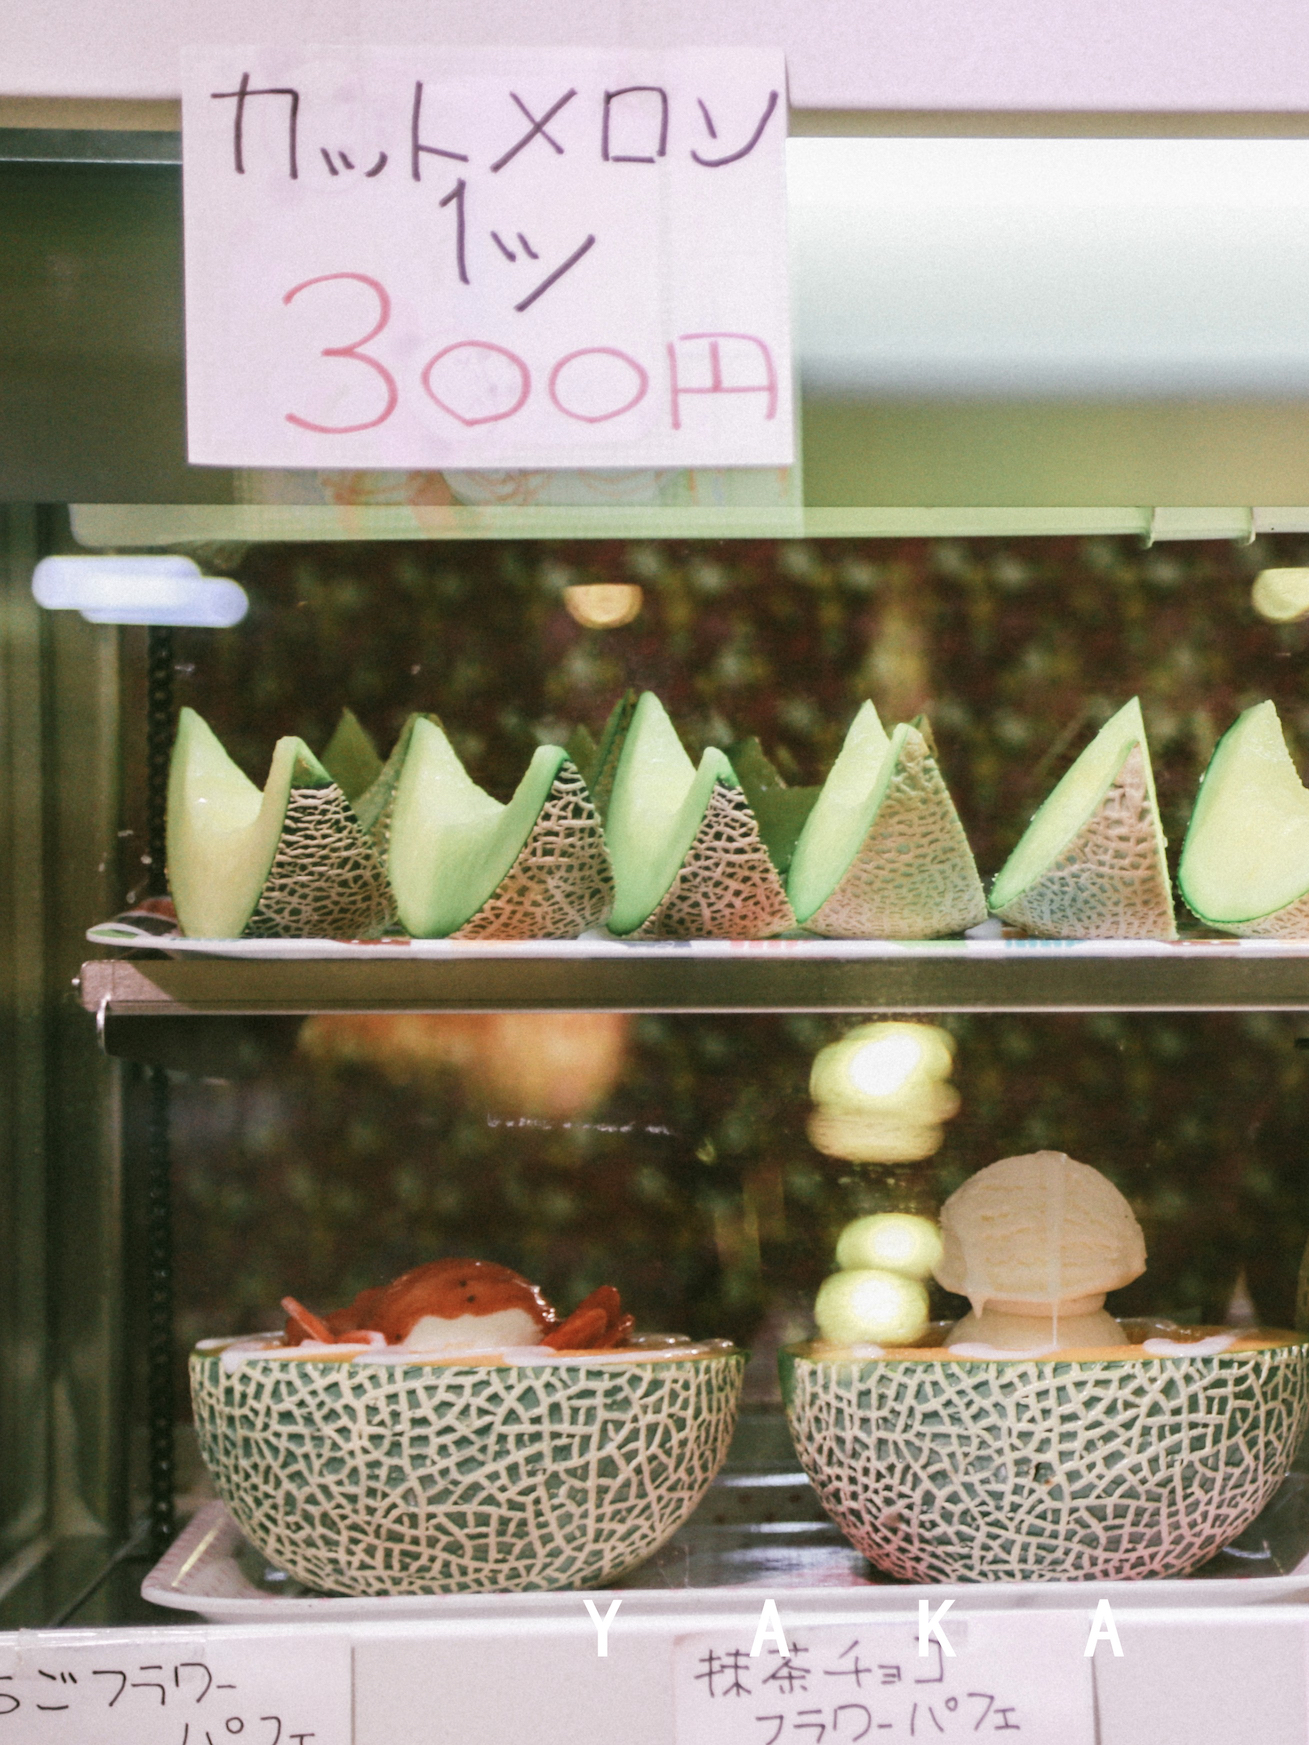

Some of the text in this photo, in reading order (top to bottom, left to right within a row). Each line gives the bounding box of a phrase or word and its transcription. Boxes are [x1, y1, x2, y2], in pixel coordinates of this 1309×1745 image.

[210, 72, 779, 181] カットメロン
[283, 271, 778, 434] 300円
[694, 1636, 944, 1698] 抹茶チョコ
[755, 1691, 1021, 1745] フラワーパフェ
